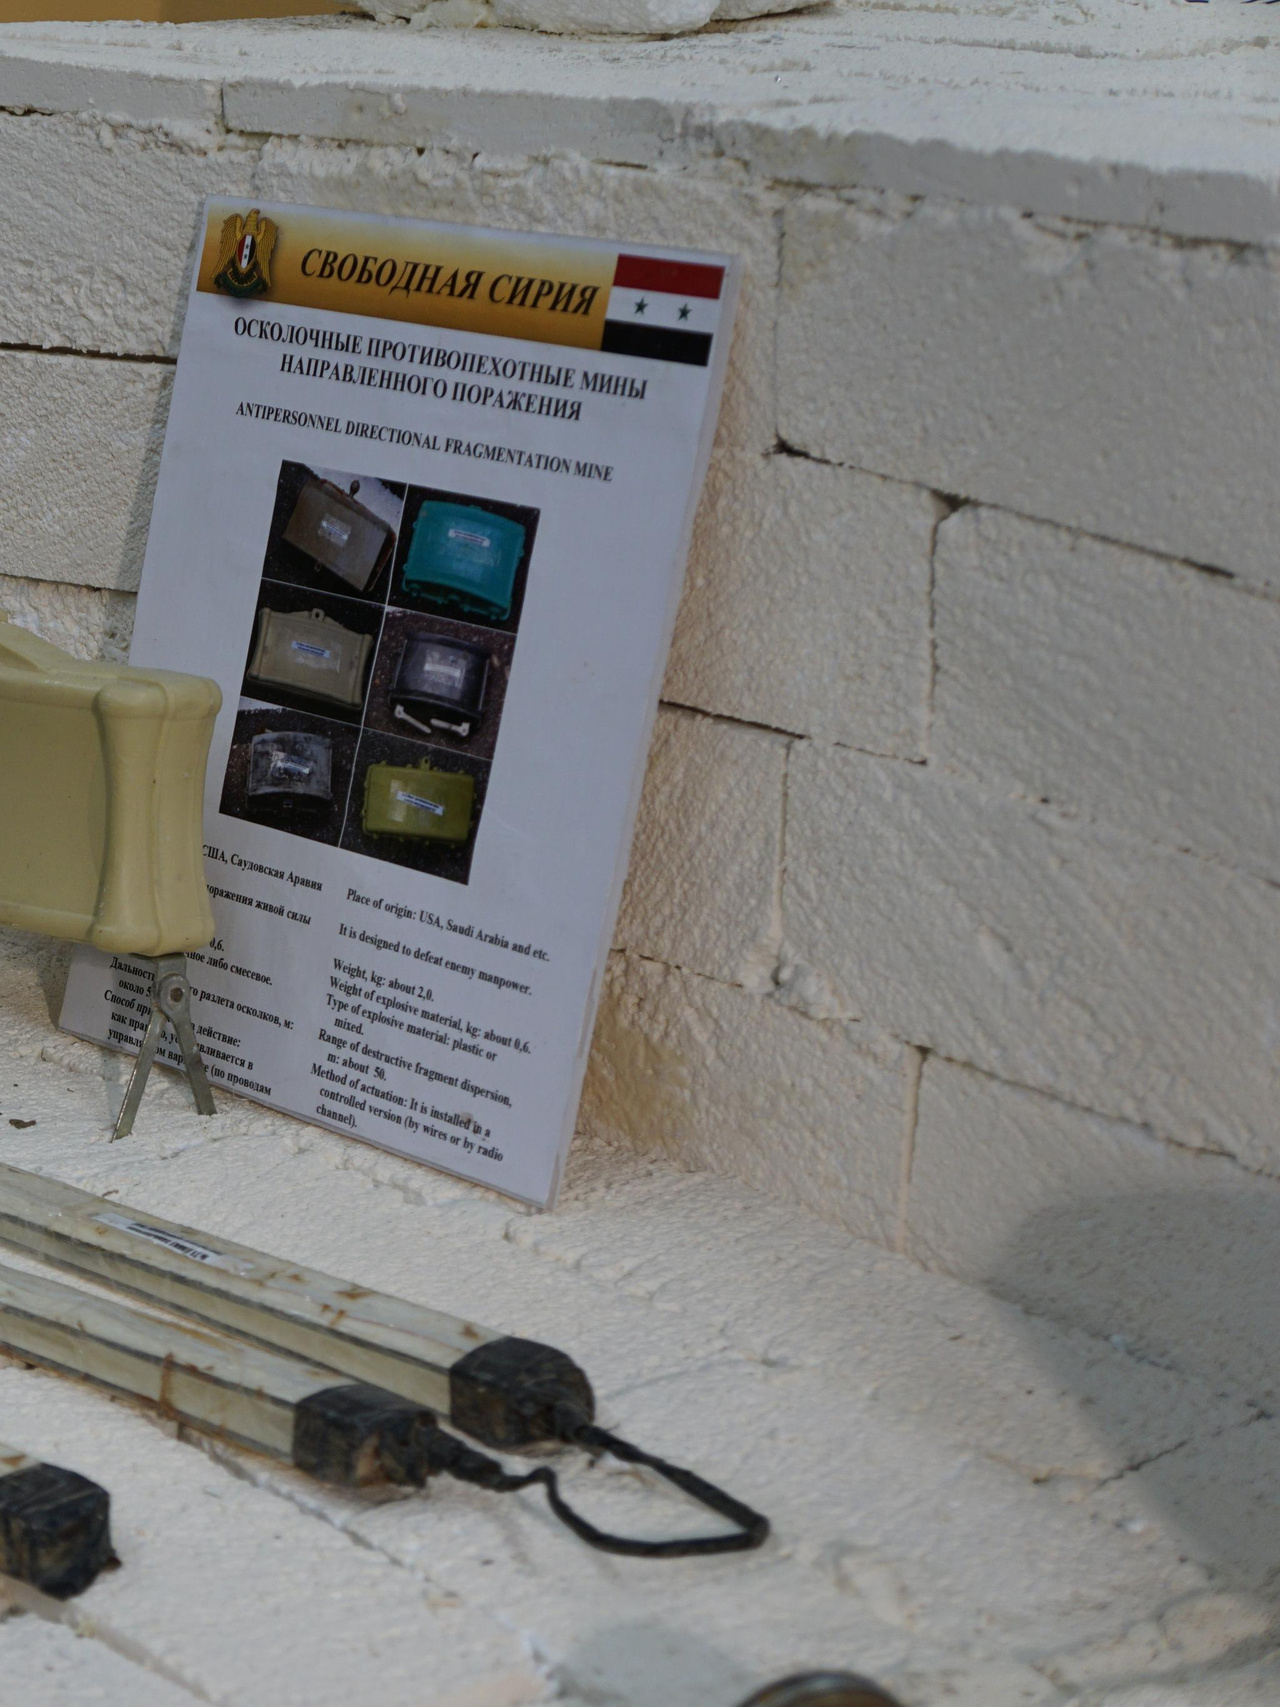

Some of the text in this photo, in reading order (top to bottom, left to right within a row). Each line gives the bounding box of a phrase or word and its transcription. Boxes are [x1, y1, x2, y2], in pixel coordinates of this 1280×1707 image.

[301, 249, 599, 315] СВОБОДНАЯ СИРИЯ
[235, 317, 647, 399] ОСКОЛОЧНЫЕ ПРОТИВОПЕХОТНЫЕ МИНЫ
[280, 354, 581, 420] НАПРАВЛЕННОГО ПОРАЖЕНИЯ
[236, 402, 613, 481] ANTIPERSONNEL DIRECTIONAL FRAGMENTATION MINE
[231, 854, 284, 879] Саудовская
[286, 872, 322, 891] Аравия
[255, 900, 284, 916] живой
[287, 911, 311, 924] силы
[347, 888, 549, 961] Place of origin: USA, Saudi Arabia and etc.
[119, 980, 144, 994] около
[207, 957, 228, 970] либо
[230, 965, 272, 985] смесевое.
[334, 958, 433, 1001] Weight, kg: about 2,0.
[339, 924, 531, 995] It is designed to defeat enemy manpower.
[104, 990, 136, 1009] Способ
[196, 1026, 240, 1047] действие:
[199, 991, 234, 1009] разлета
[237, 1004, 281, 1027] осколков,
[284, 1020, 293, 1029] м:
[327, 993, 497, 1061] Type of explosive material: plastic or
[330, 976, 531, 1054] Weight of explosive material, kg: about 0,6.
[334, 1018, 363, 1035] mixed.
[111, 1012, 127, 1024] как
[247, 1062, 253, 1070] в
[318, 1029, 511, 1108] Range of destructive fragment dispersion,
[327, 1053, 386, 1081] m: about 50.
[211, 1065, 225, 1078] (по
[227, 1073, 271, 1095] проводам
[311, 1063, 490, 1137] Method of actuation: It is installed in a
[316, 1104, 357, 1128] channel).
[320, 1088, 503, 1161] controlled version (by wires or by radio
